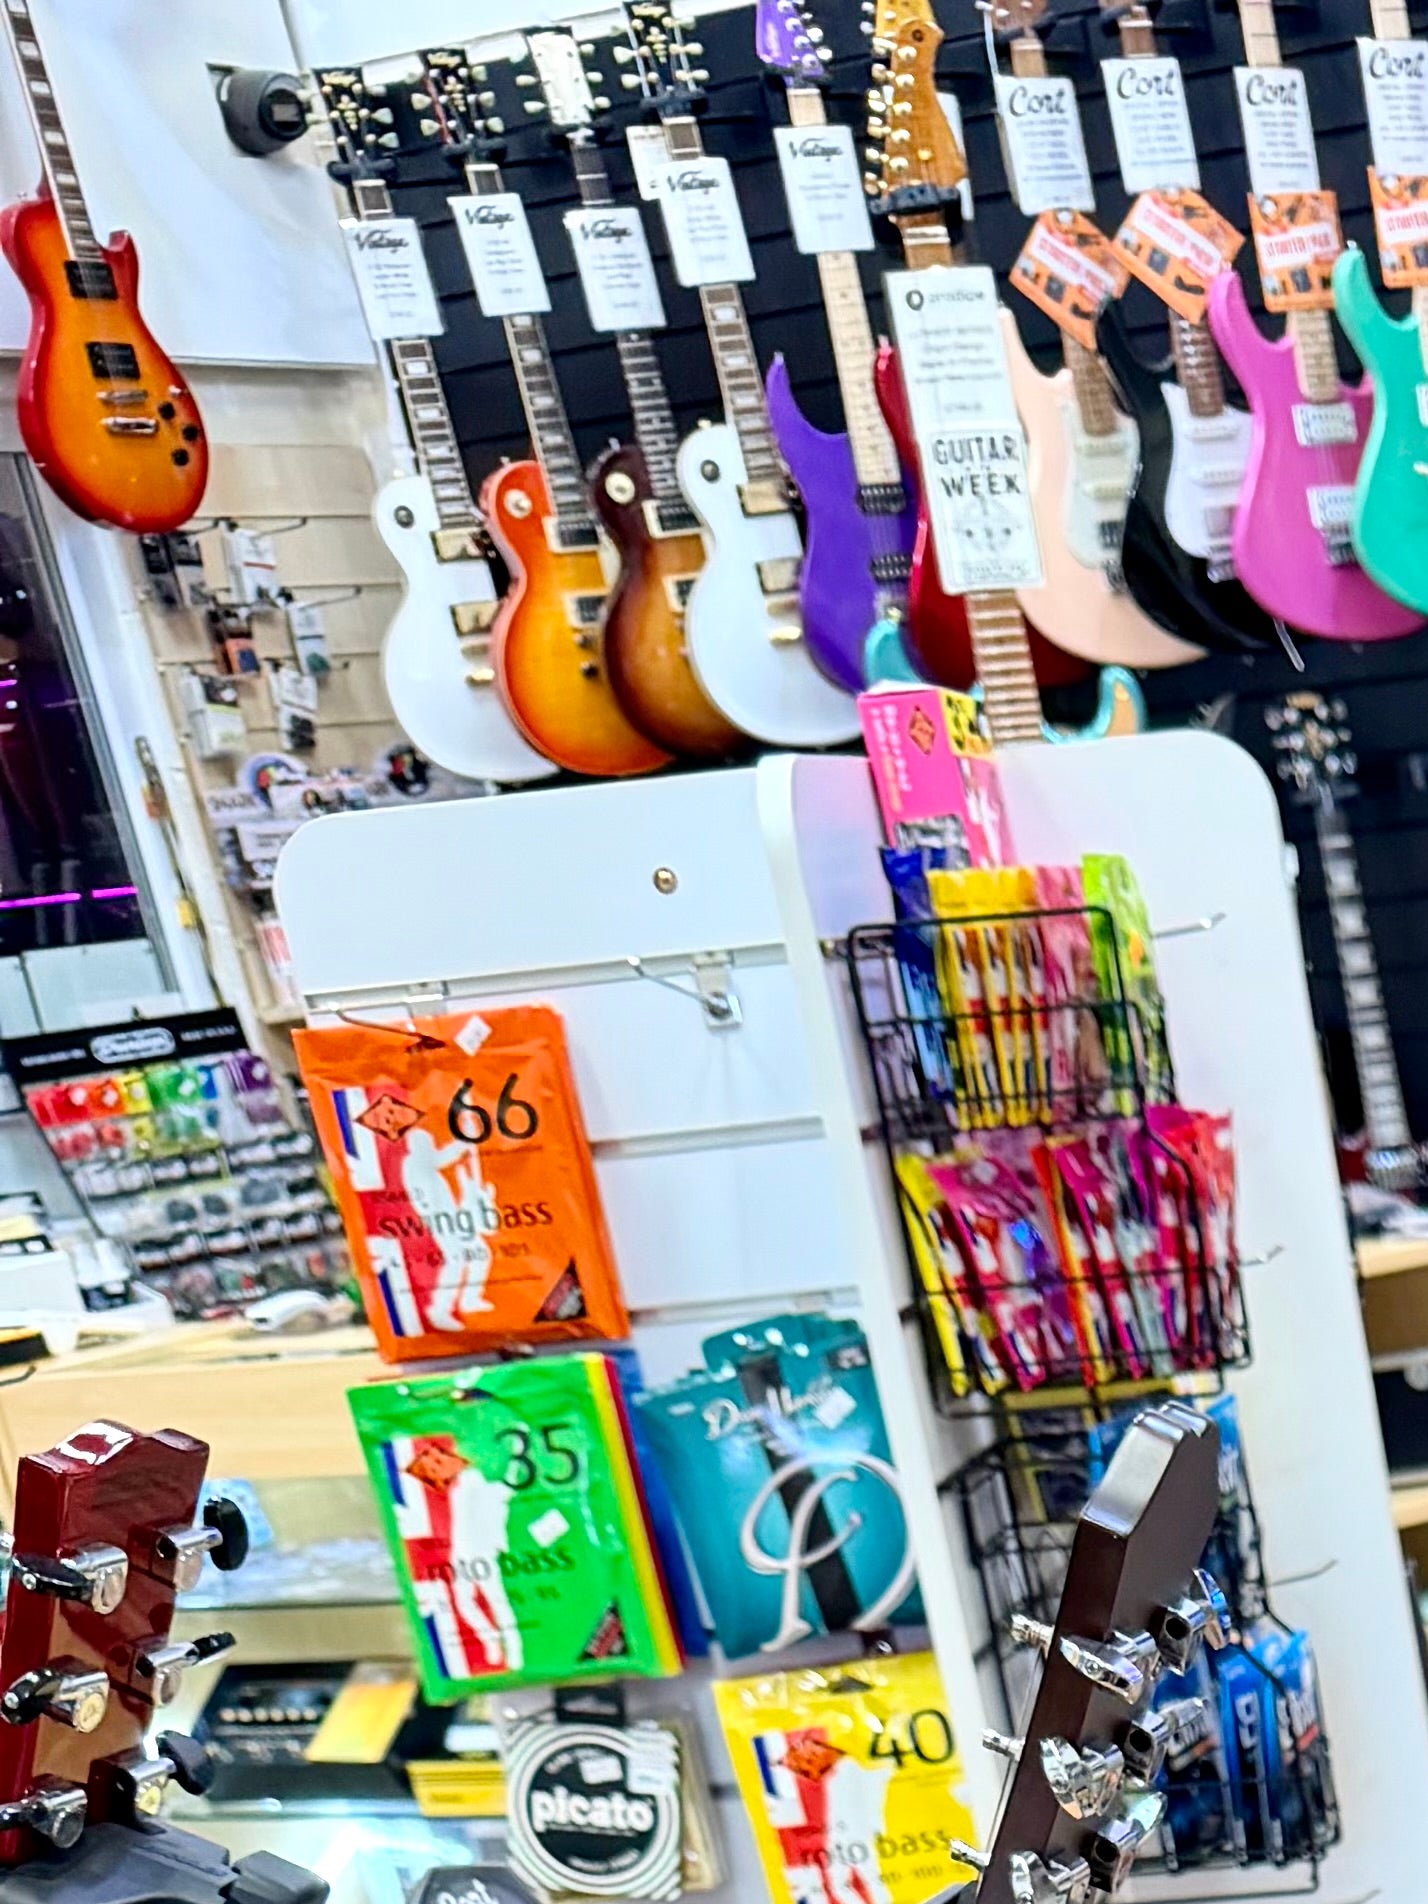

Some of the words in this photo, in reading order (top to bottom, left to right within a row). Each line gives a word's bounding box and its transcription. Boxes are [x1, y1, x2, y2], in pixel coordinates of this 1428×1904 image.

[1369, 45, 1426, 81] Cort
[1116, 67, 1176, 100] Cort
[1246, 74, 1301, 107] Cort
[1008, 84, 1067, 118] Cort
[933, 436, 1019, 466] GUITAR
[941, 473, 1021, 498] WEEK
[447, 1073, 539, 1145] 66
[378, 1209, 475, 1241] swing
[480, 1197, 554, 1230] bass
[494, 1423, 581, 1491] 35
[498, 1547, 576, 1577] bass
[870, 1709, 955, 1768] 40
[530, 1785, 655, 1833] picato
[875, 1829, 951, 1860] bass
